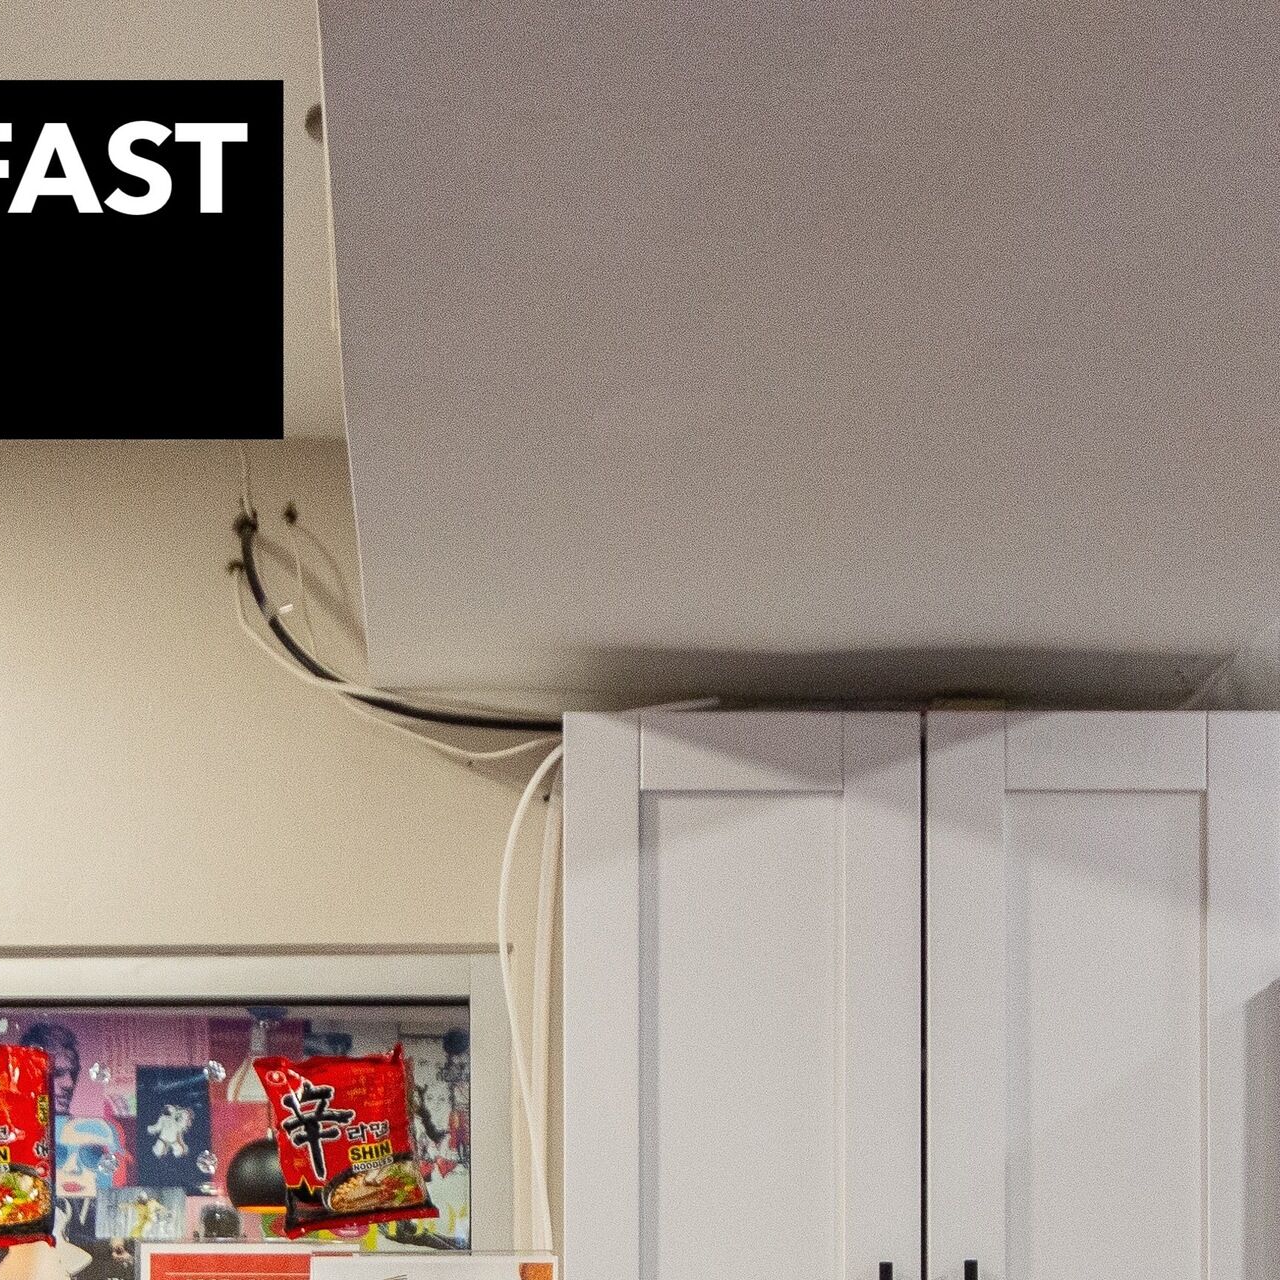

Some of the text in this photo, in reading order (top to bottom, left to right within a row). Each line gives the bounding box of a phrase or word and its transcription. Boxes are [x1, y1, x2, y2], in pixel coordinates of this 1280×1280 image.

[281, 1081, 355, 1180] 辛
[346, 1121, 389, 1143] 라면
[350, 1143, 391, 1162] SHIN
[353, 1156, 393, 1172] NOODLES
